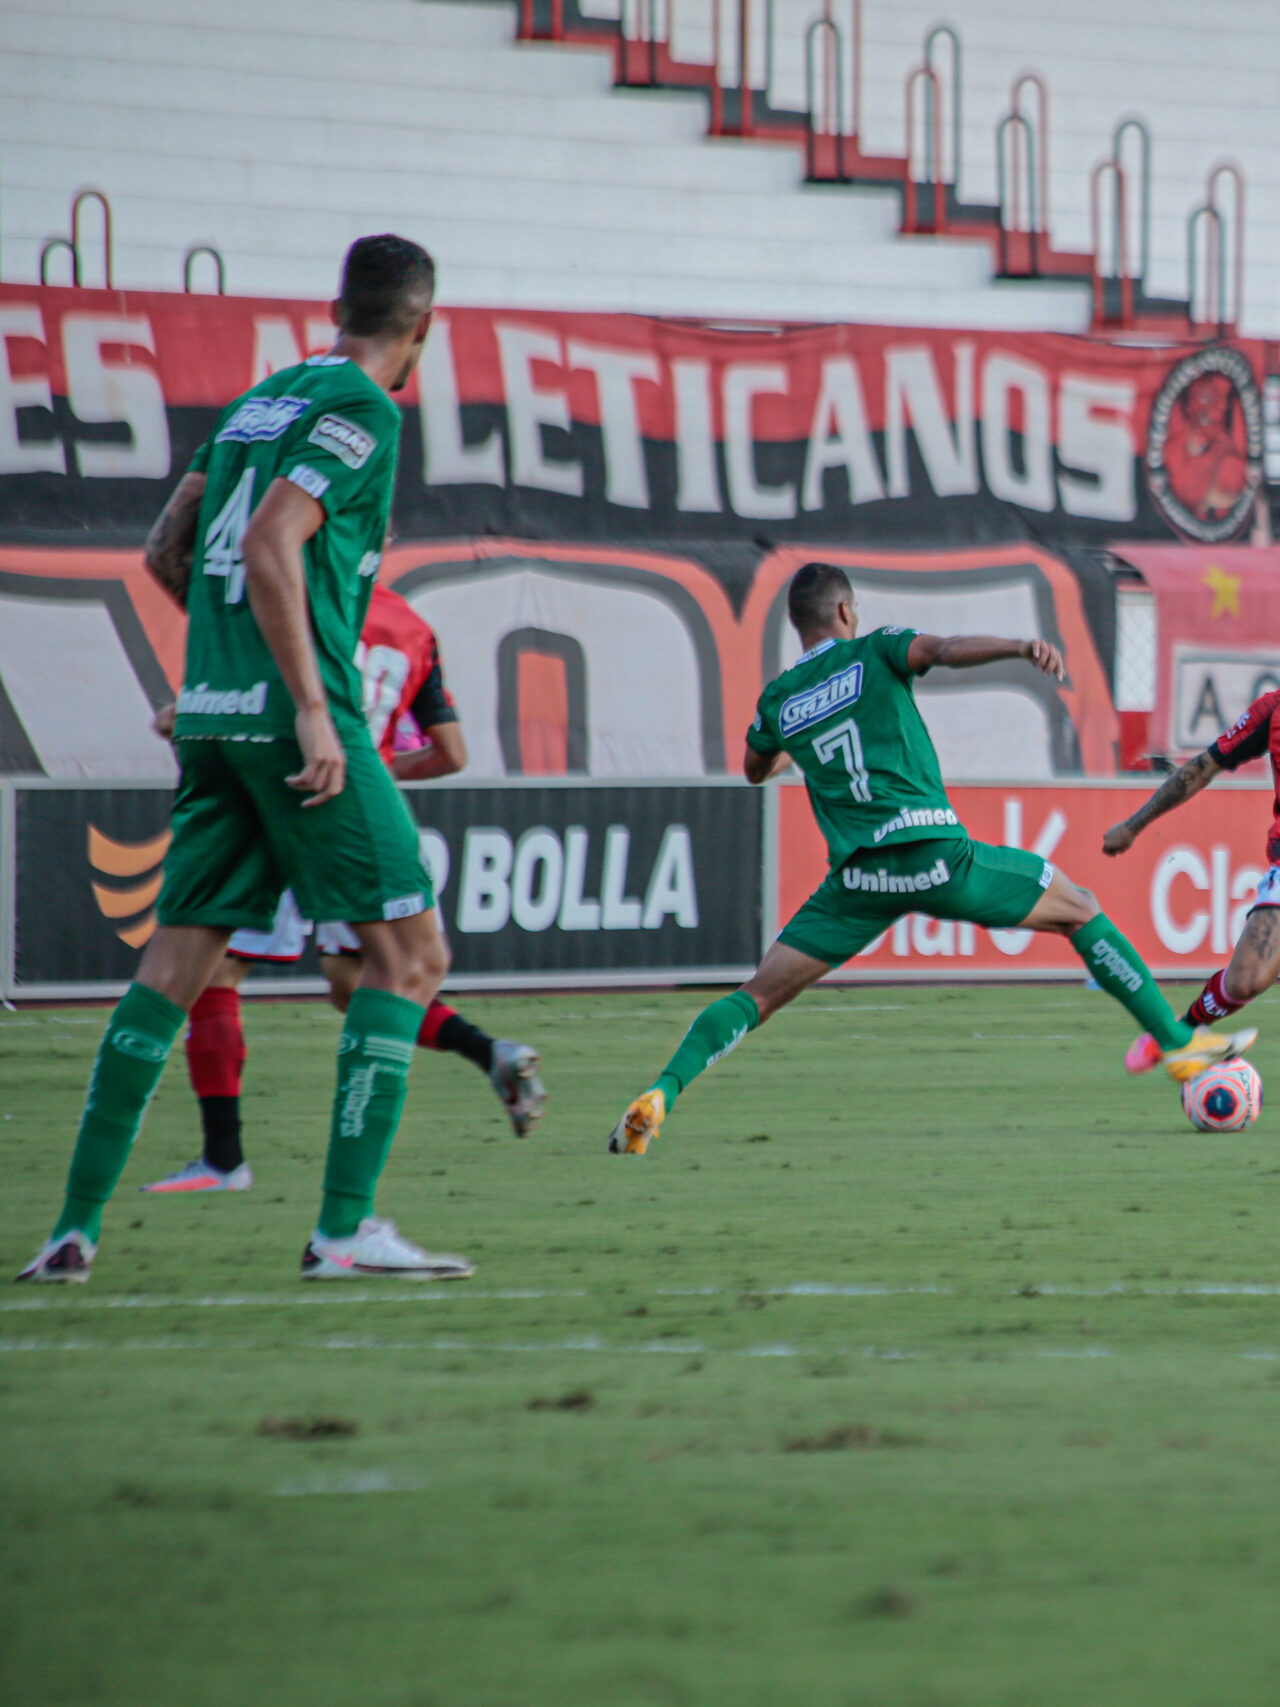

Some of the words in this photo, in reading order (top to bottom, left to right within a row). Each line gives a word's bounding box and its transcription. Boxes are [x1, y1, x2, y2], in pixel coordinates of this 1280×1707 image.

[203, 466, 257, 605] 4
[812, 718, 873, 803] 7
[456, 823, 699, 933] BOLLA
[842, 858, 950, 893] Unimed
